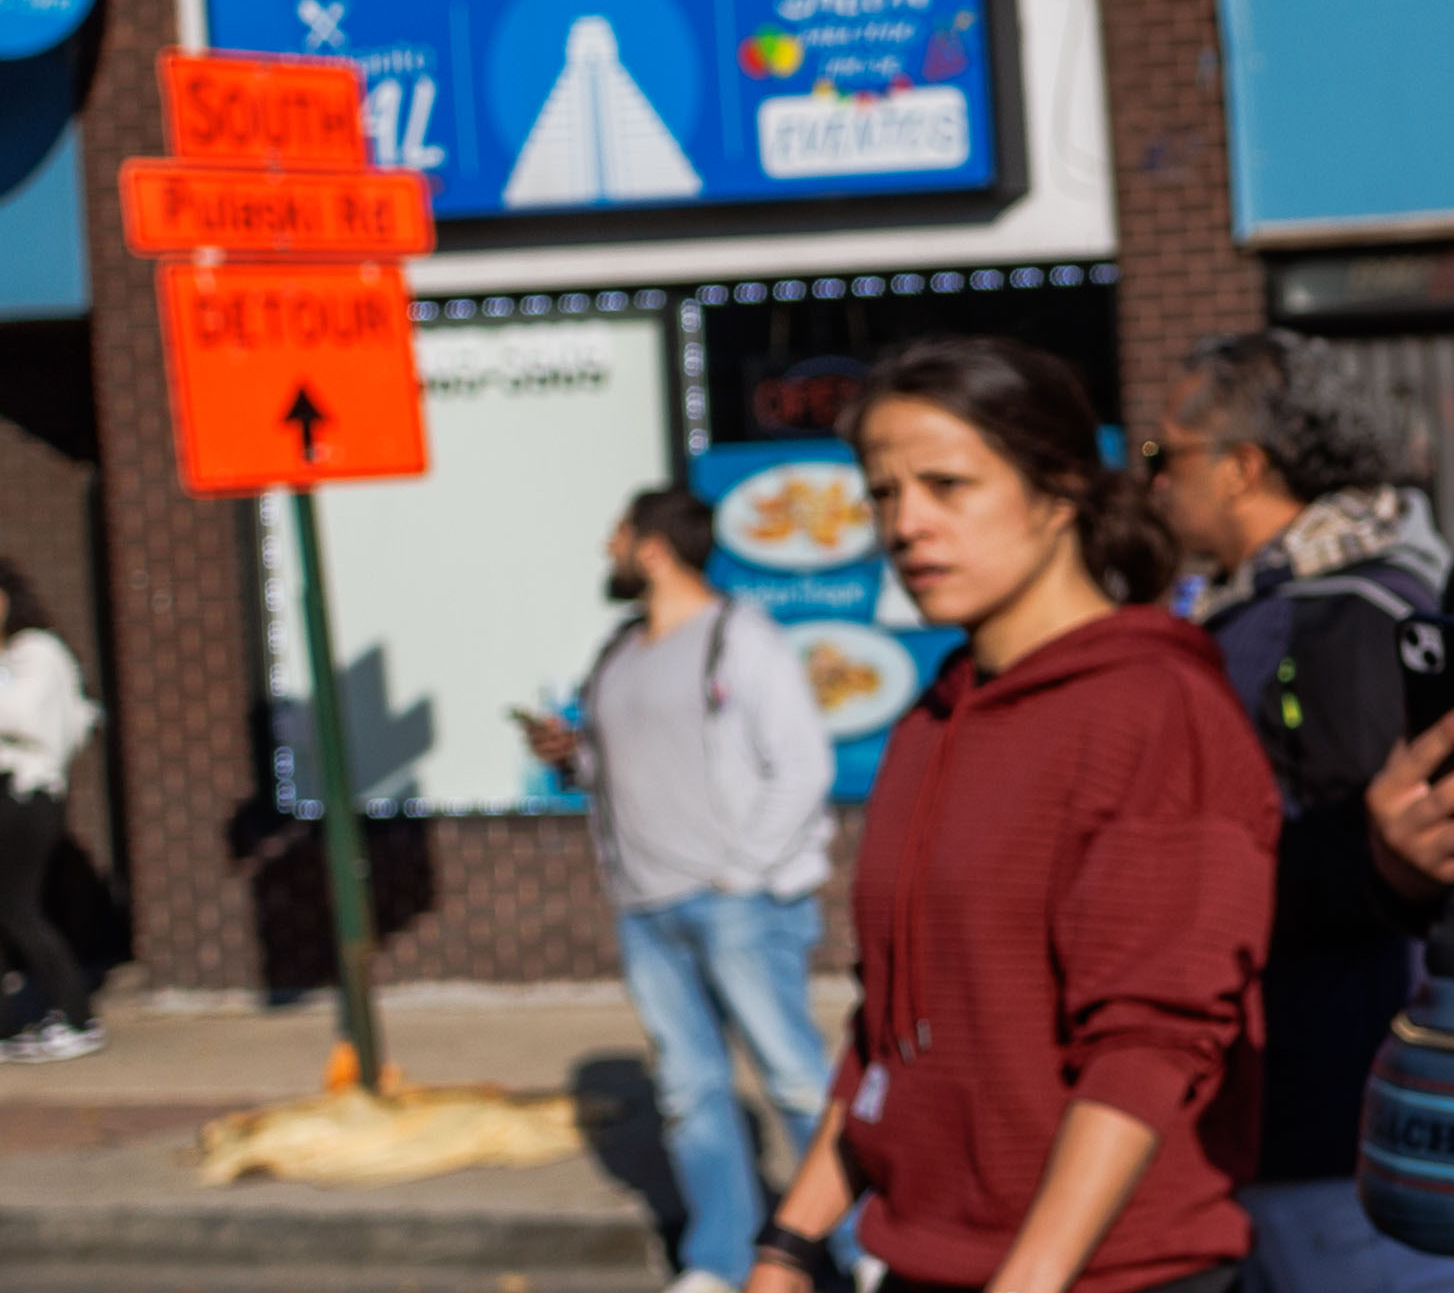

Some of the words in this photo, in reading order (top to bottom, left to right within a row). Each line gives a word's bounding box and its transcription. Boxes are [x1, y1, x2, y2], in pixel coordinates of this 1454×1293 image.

[187, 75, 355, 146] SOUTH
[163, 178, 320, 233] Pulaski
[339, 189, 394, 237] Rd
[195, 292, 388, 347] DETOUR
